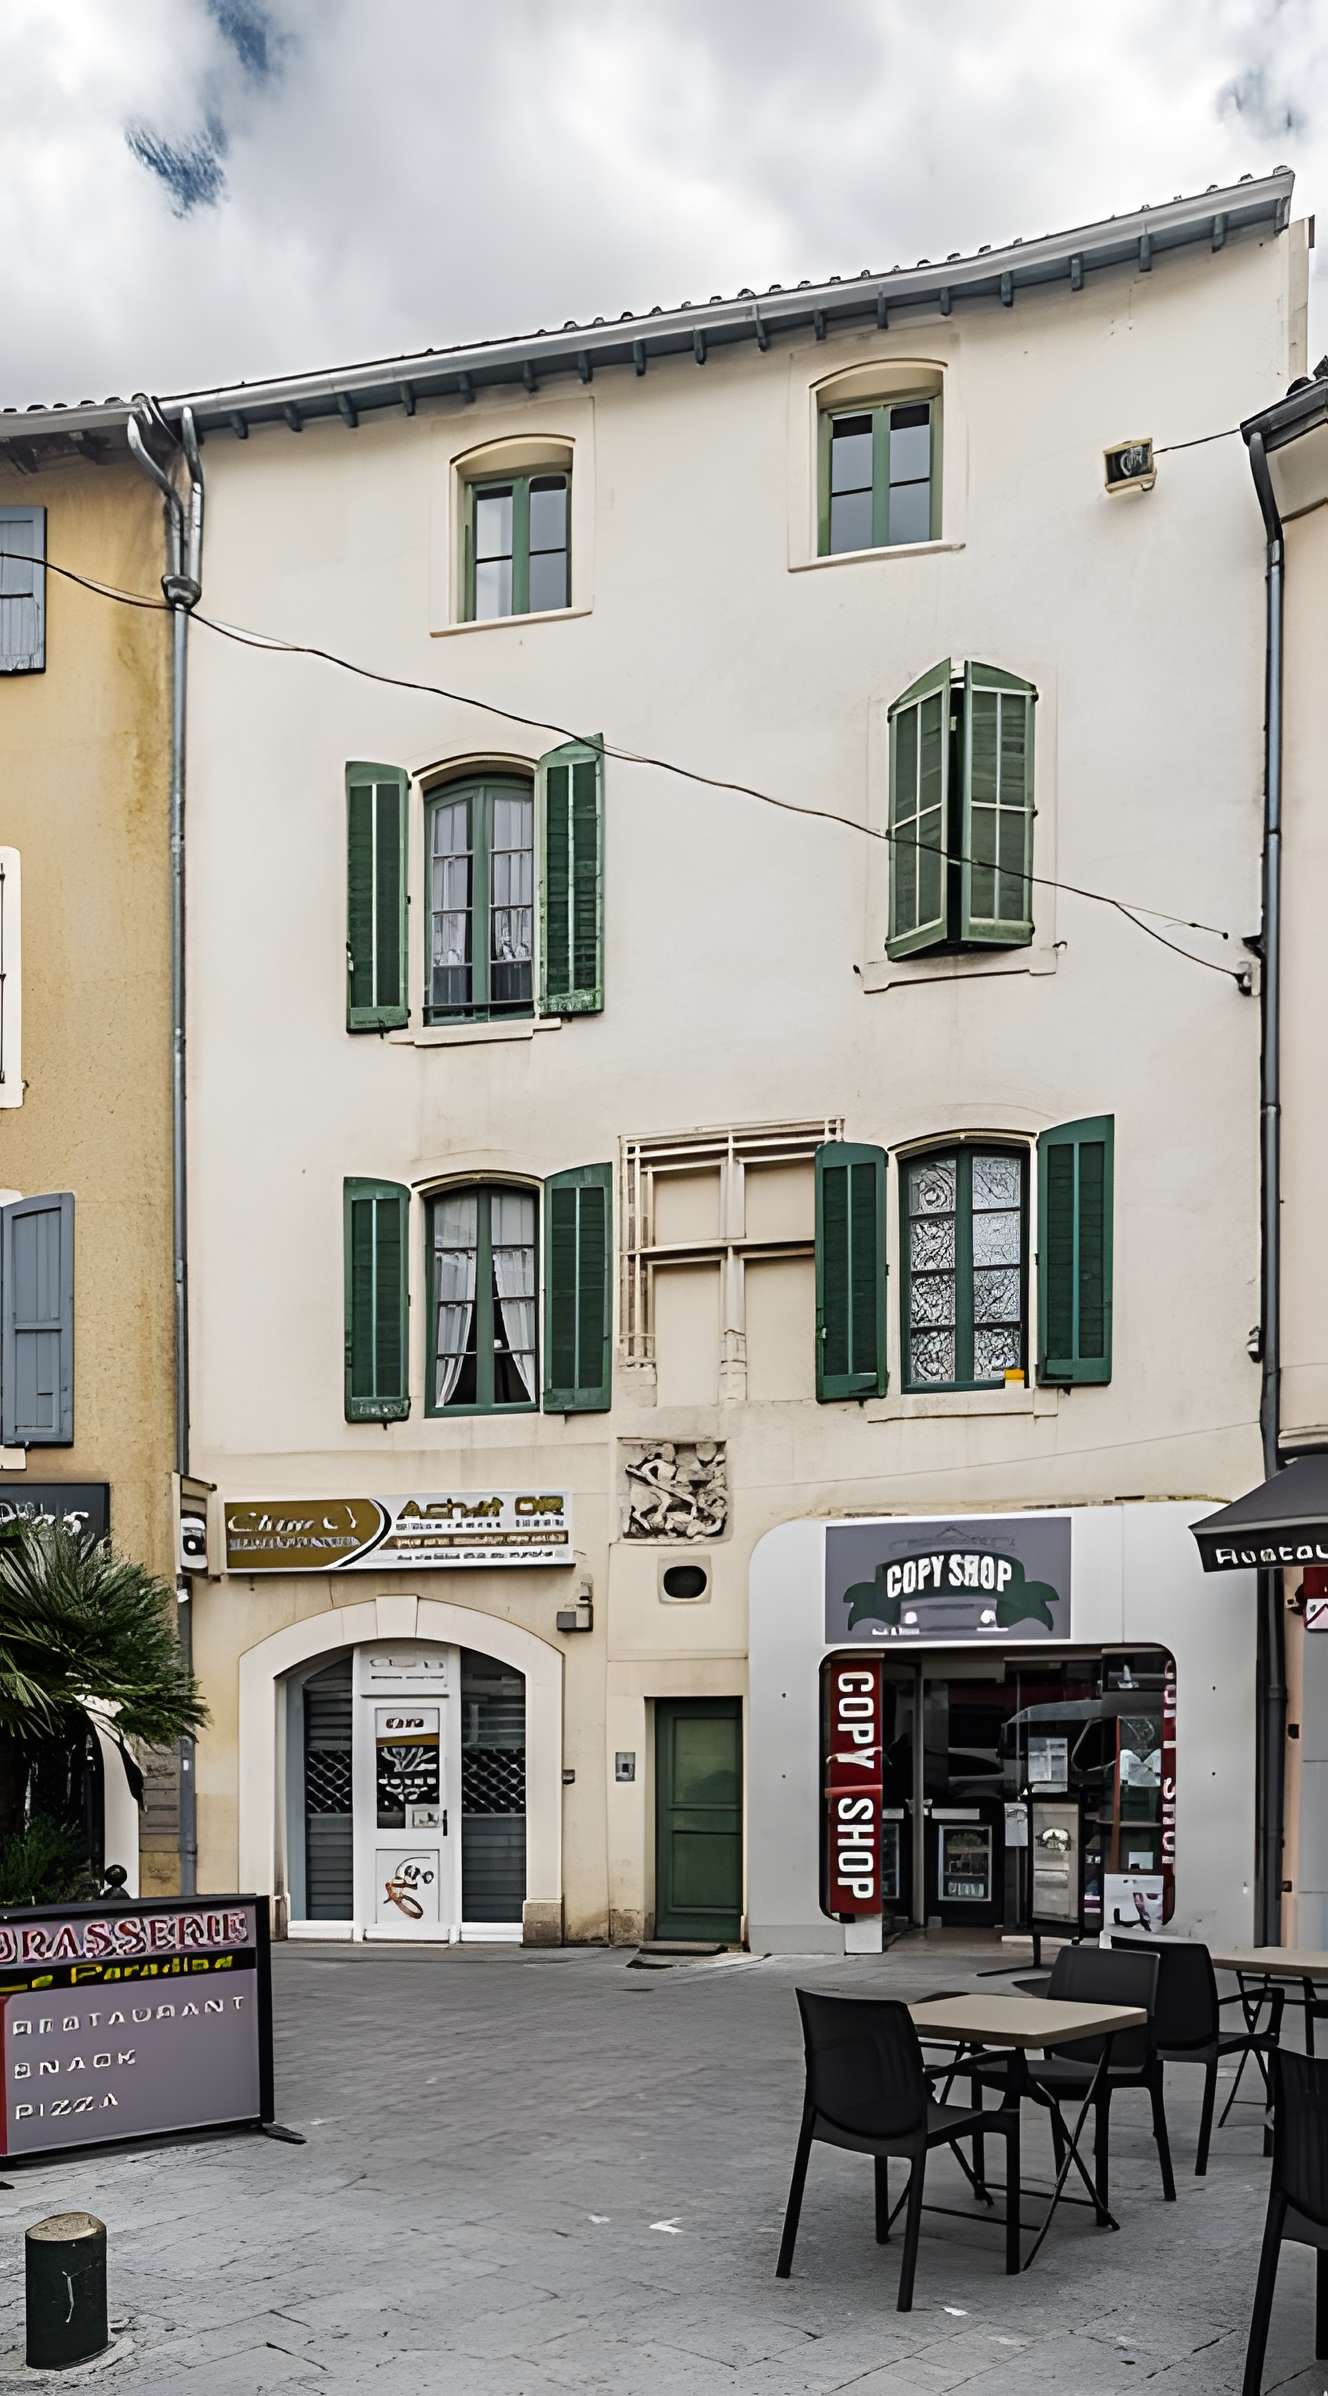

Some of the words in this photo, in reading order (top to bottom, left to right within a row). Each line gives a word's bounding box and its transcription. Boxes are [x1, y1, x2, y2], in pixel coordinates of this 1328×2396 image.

[886, 1554, 945, 1599] COPY
[949, 1553, 1013, 1593] SHOP
[837, 1671, 875, 1769] COPY
[837, 1797, 875, 1899] SHOP
[15, 2093, 120, 2120] PIZZA
